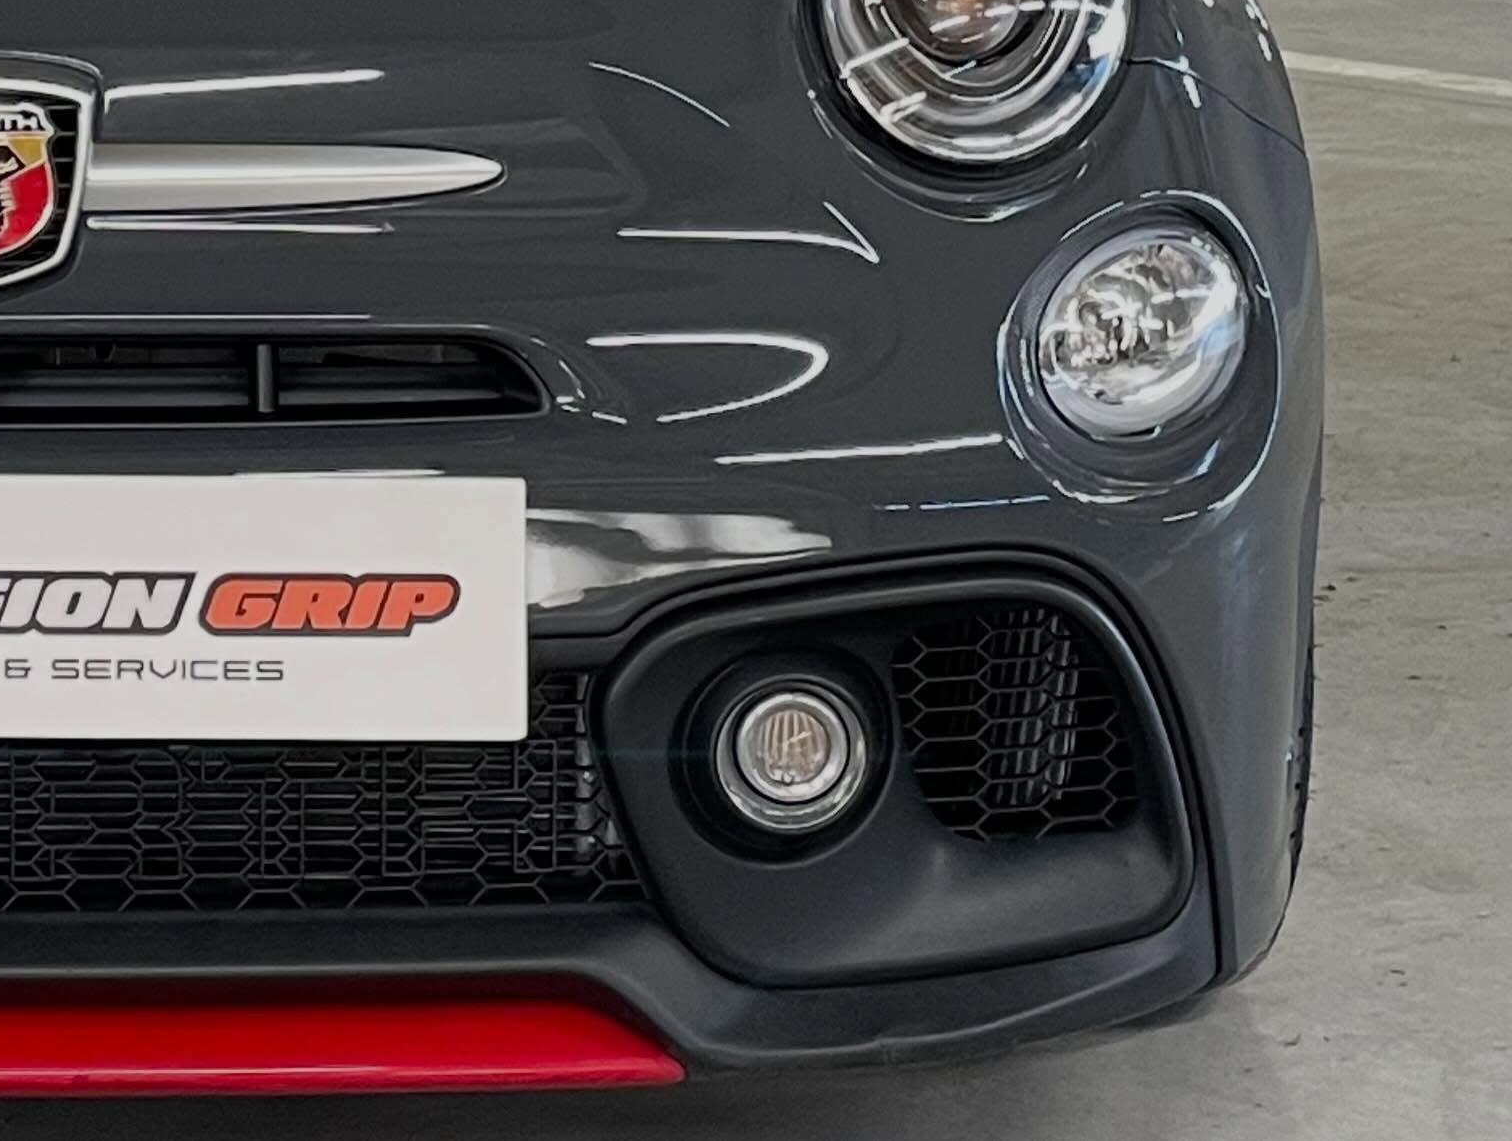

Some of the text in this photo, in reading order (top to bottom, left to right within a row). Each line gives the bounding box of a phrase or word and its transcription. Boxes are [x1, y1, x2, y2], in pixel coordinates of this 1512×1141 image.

[200, 573, 460, 636] GRIP
[4, 659, 30, 678] &
[51, 659, 285, 681] SERVICES
